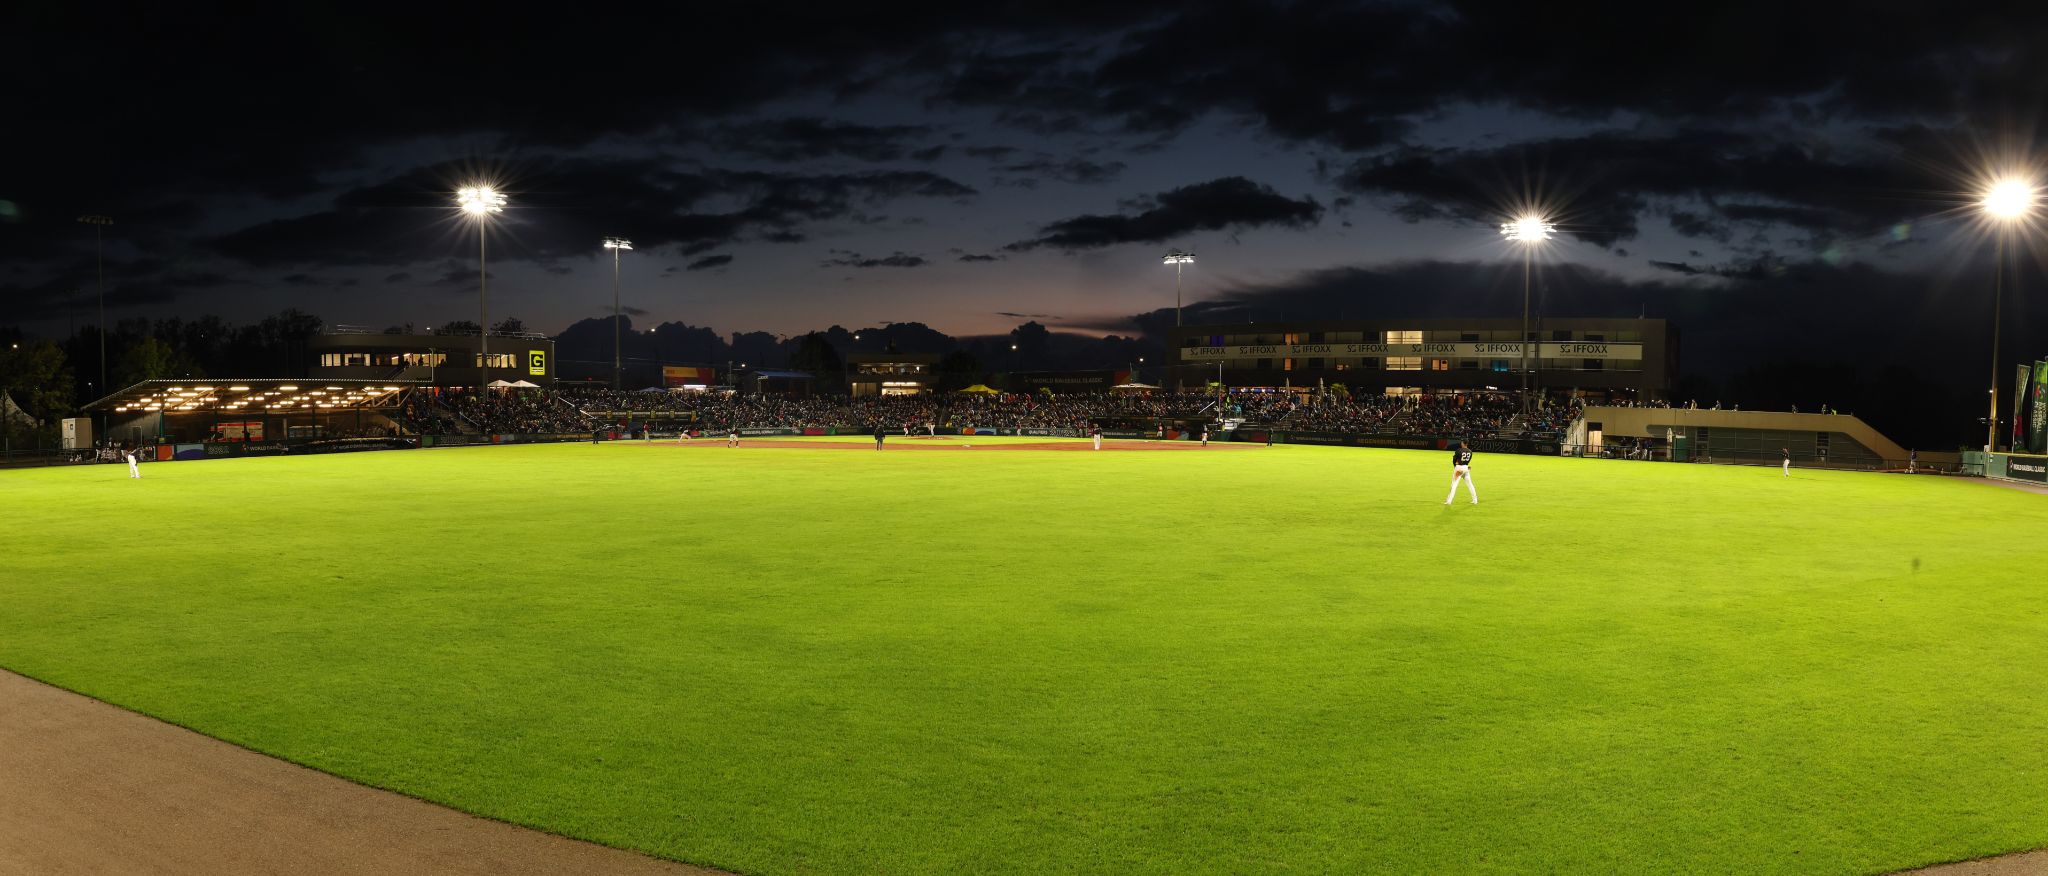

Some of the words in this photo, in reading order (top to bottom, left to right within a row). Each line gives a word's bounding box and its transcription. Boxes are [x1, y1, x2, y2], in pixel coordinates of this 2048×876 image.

[1200, 347, 1226, 355] IFFOXX
[1249, 345, 1277, 354] IFFOXX
[1302, 345, 1331, 353] IFFOXX
[1358, 344, 1388, 352] IFFOXX
[1424, 344, 1456, 352] IFFOXX
[1487, 344, 1520, 352] IFFOXX
[1573, 344, 1608, 353] IFFOXX
